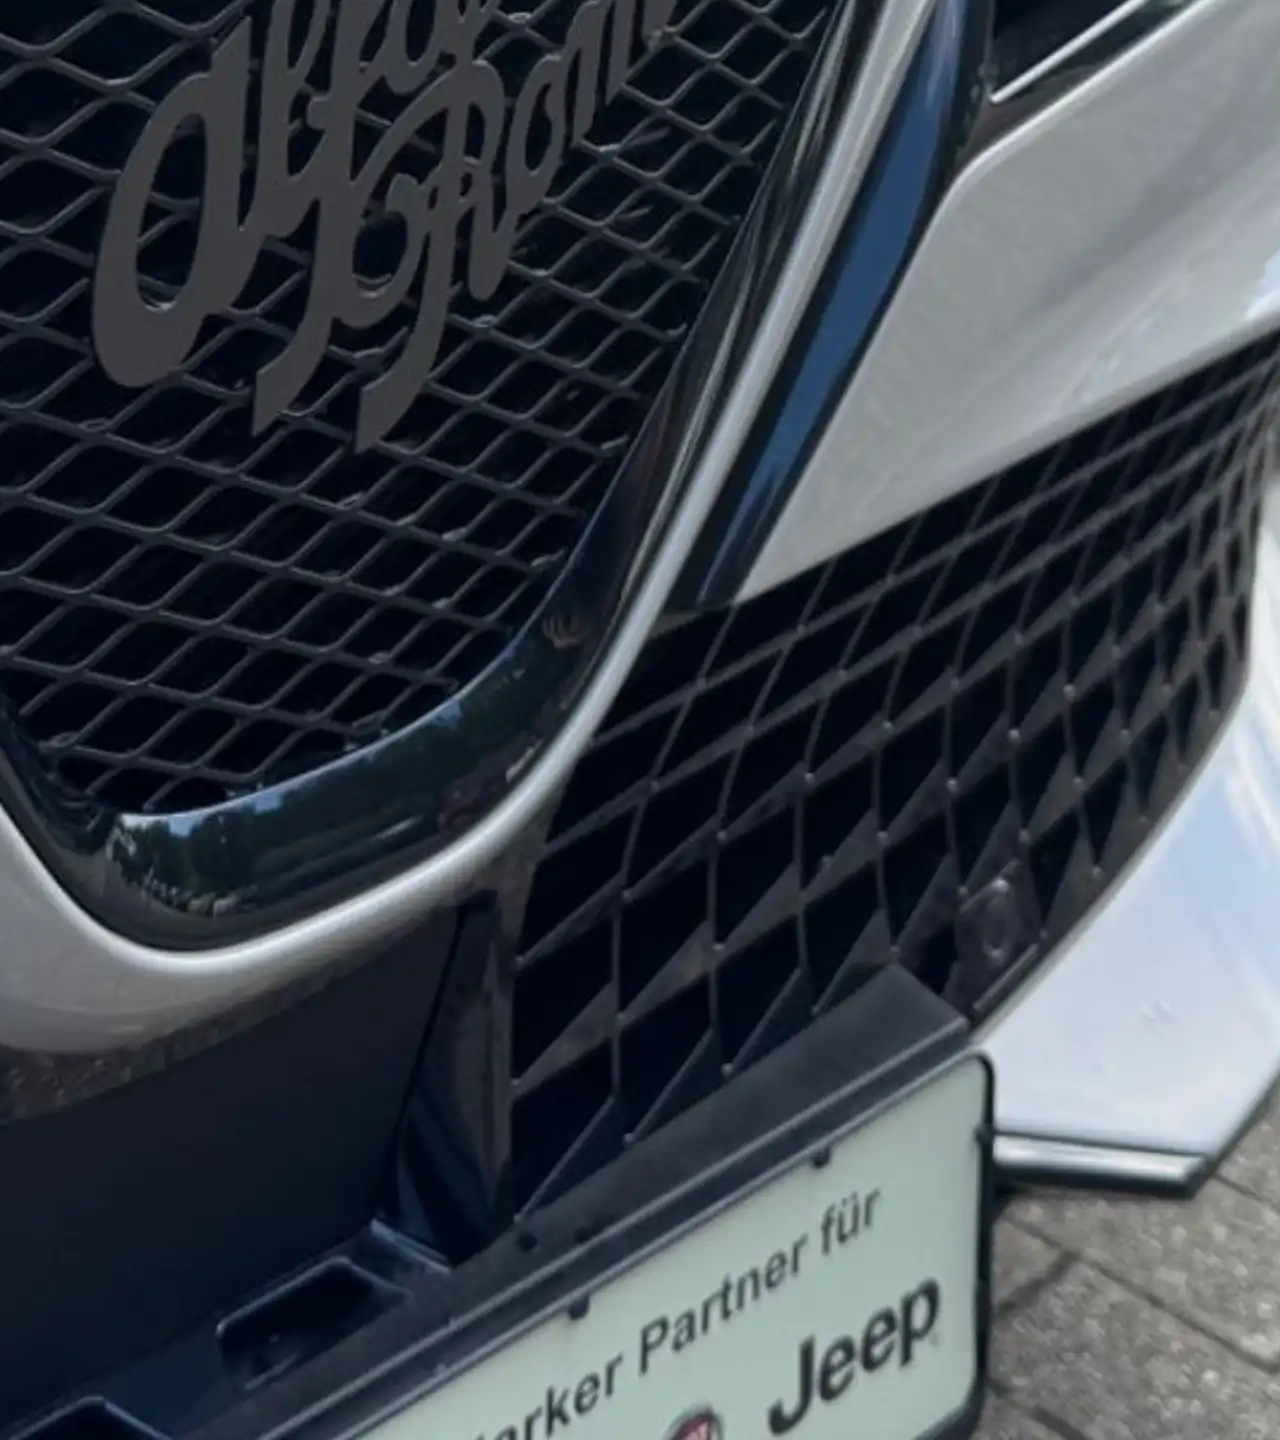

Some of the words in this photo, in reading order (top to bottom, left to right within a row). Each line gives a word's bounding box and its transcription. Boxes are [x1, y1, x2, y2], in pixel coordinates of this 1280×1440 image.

[475, 1353, 622, 1440] rker
[641, 1233, 807, 1375] Partner
[820, 1189, 880, 1255] für
[768, 1276, 939, 1435] Jeep
